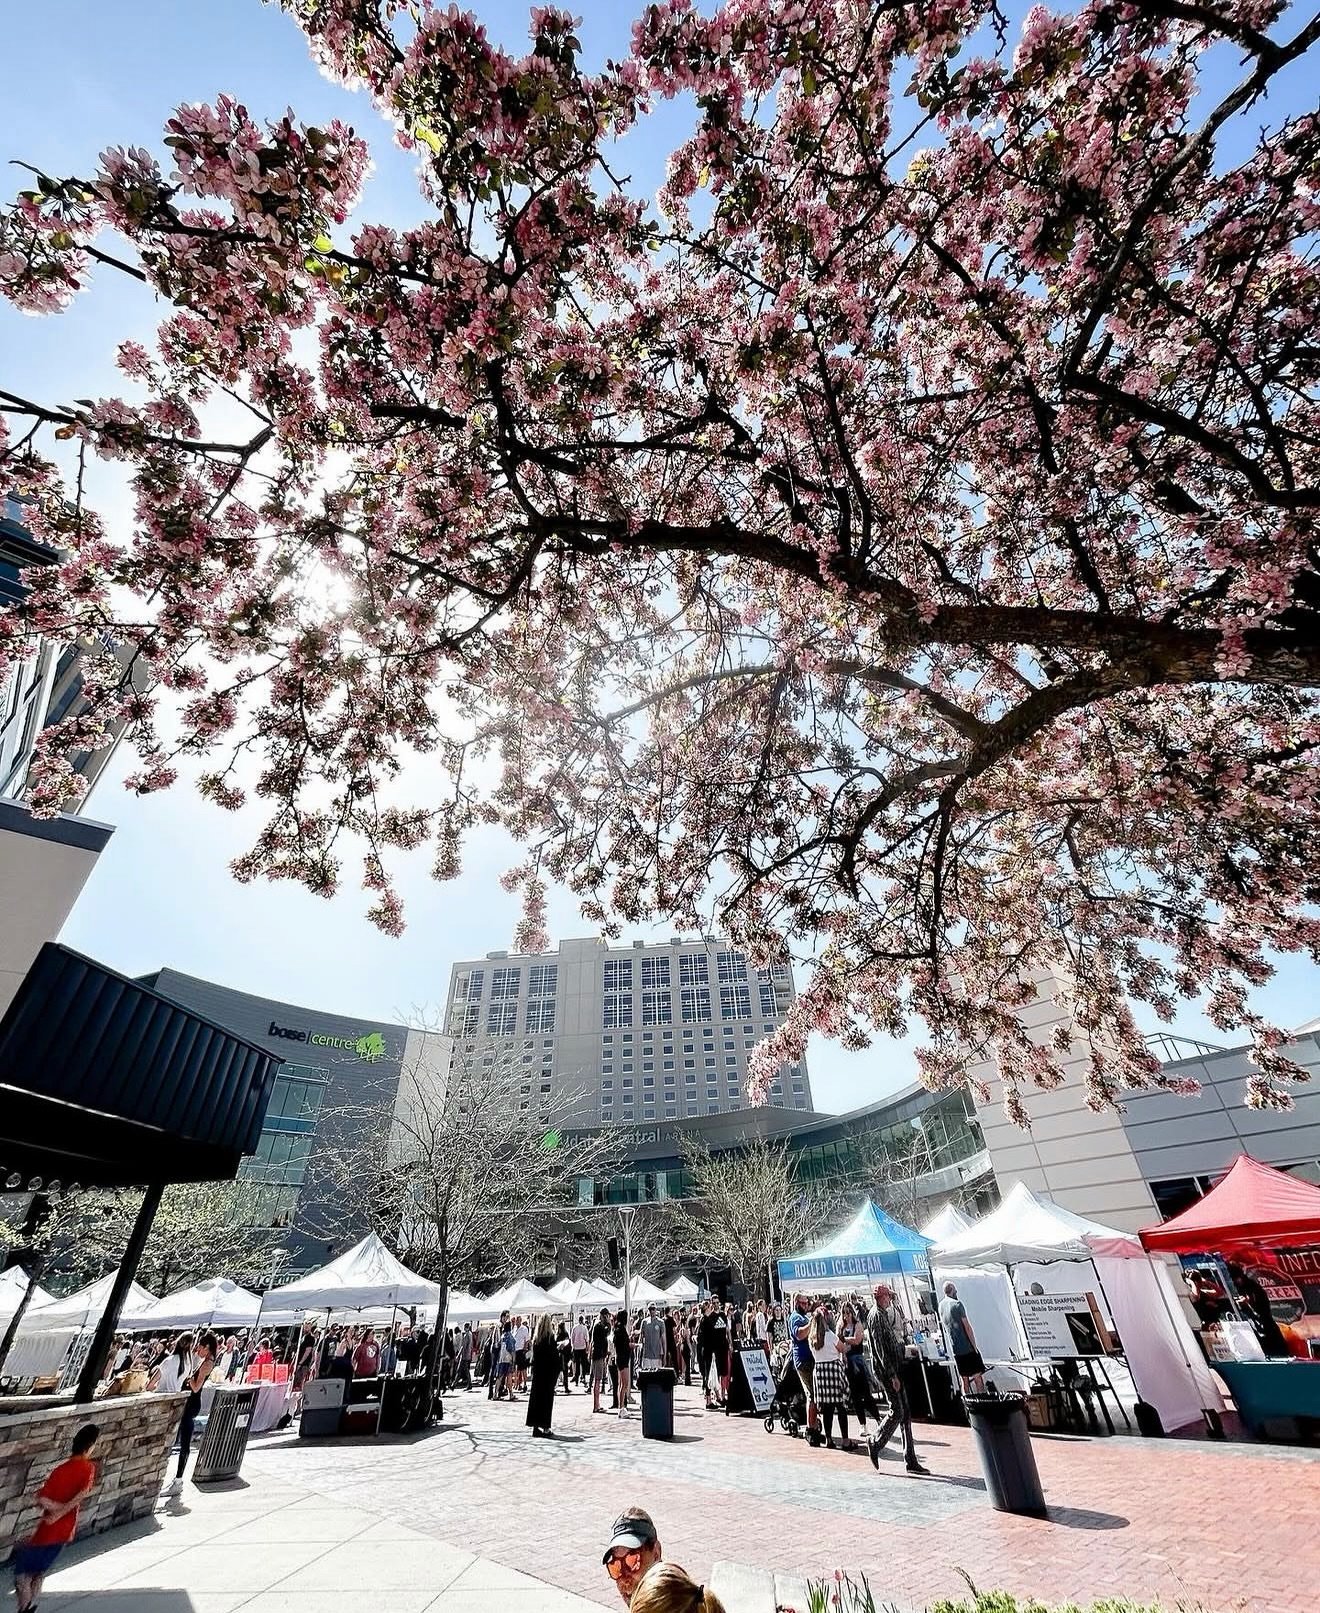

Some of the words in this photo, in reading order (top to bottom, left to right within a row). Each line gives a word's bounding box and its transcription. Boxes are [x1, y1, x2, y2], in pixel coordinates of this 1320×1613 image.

[794, 1260, 828, 1278] ROLLED
[832, 1258, 848, 1276] ICE
[849, 1256, 882, 1274] CREAM
[1267, 1287, 1300, 1299] RKET
[1054, 1296, 1086, 1304] SHARPENING
